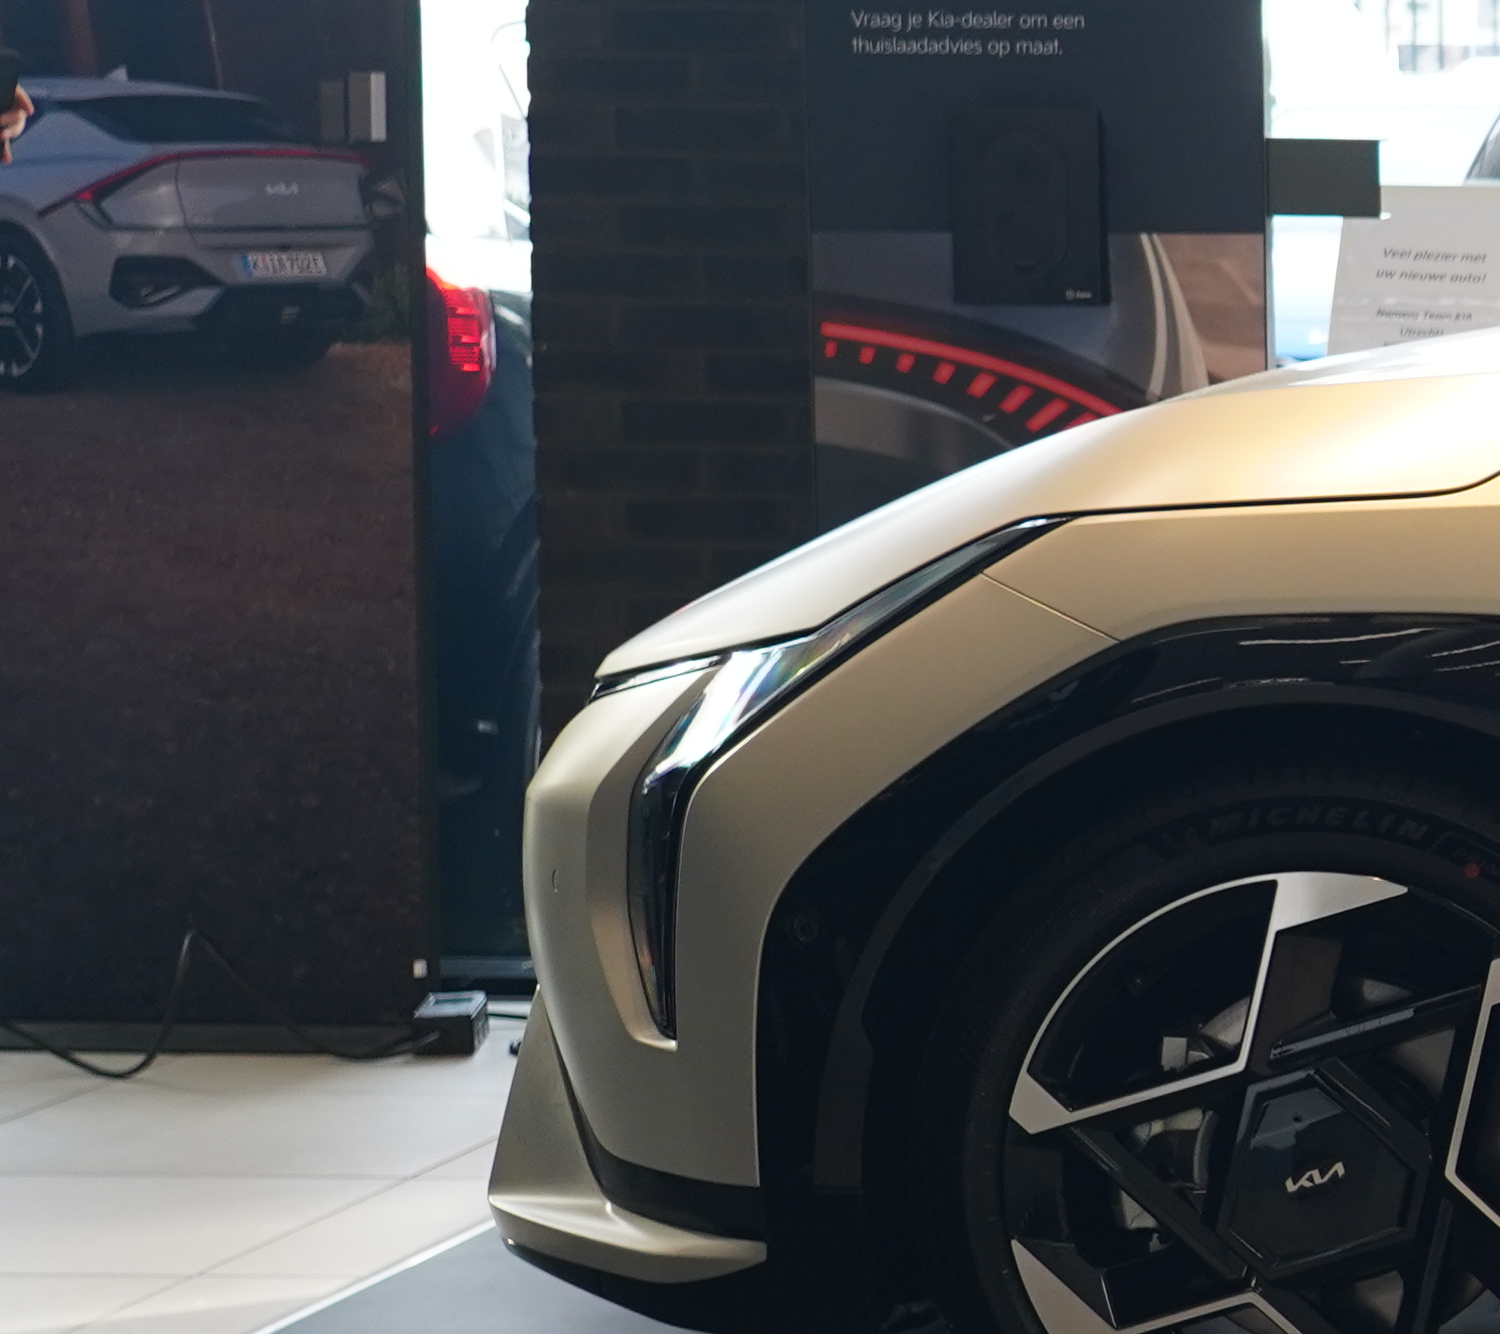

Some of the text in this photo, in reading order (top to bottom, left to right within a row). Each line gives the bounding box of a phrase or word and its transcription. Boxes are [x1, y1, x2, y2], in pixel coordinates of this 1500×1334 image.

[851, 9, 1085, 33] Vraag je Kia-dealer om een
[852, 36, 983, 56] thuislaadadvies
[987, 41, 1011, 59] op
[1383, 247, 1412, 260] Veel
[1413, 249, 1457, 263] plezier
[1399, 269, 1447, 282] nieuwe
[1208, 804, 1430, 841] MICHELIN
[1284, 1160, 1346, 1195] KIA
